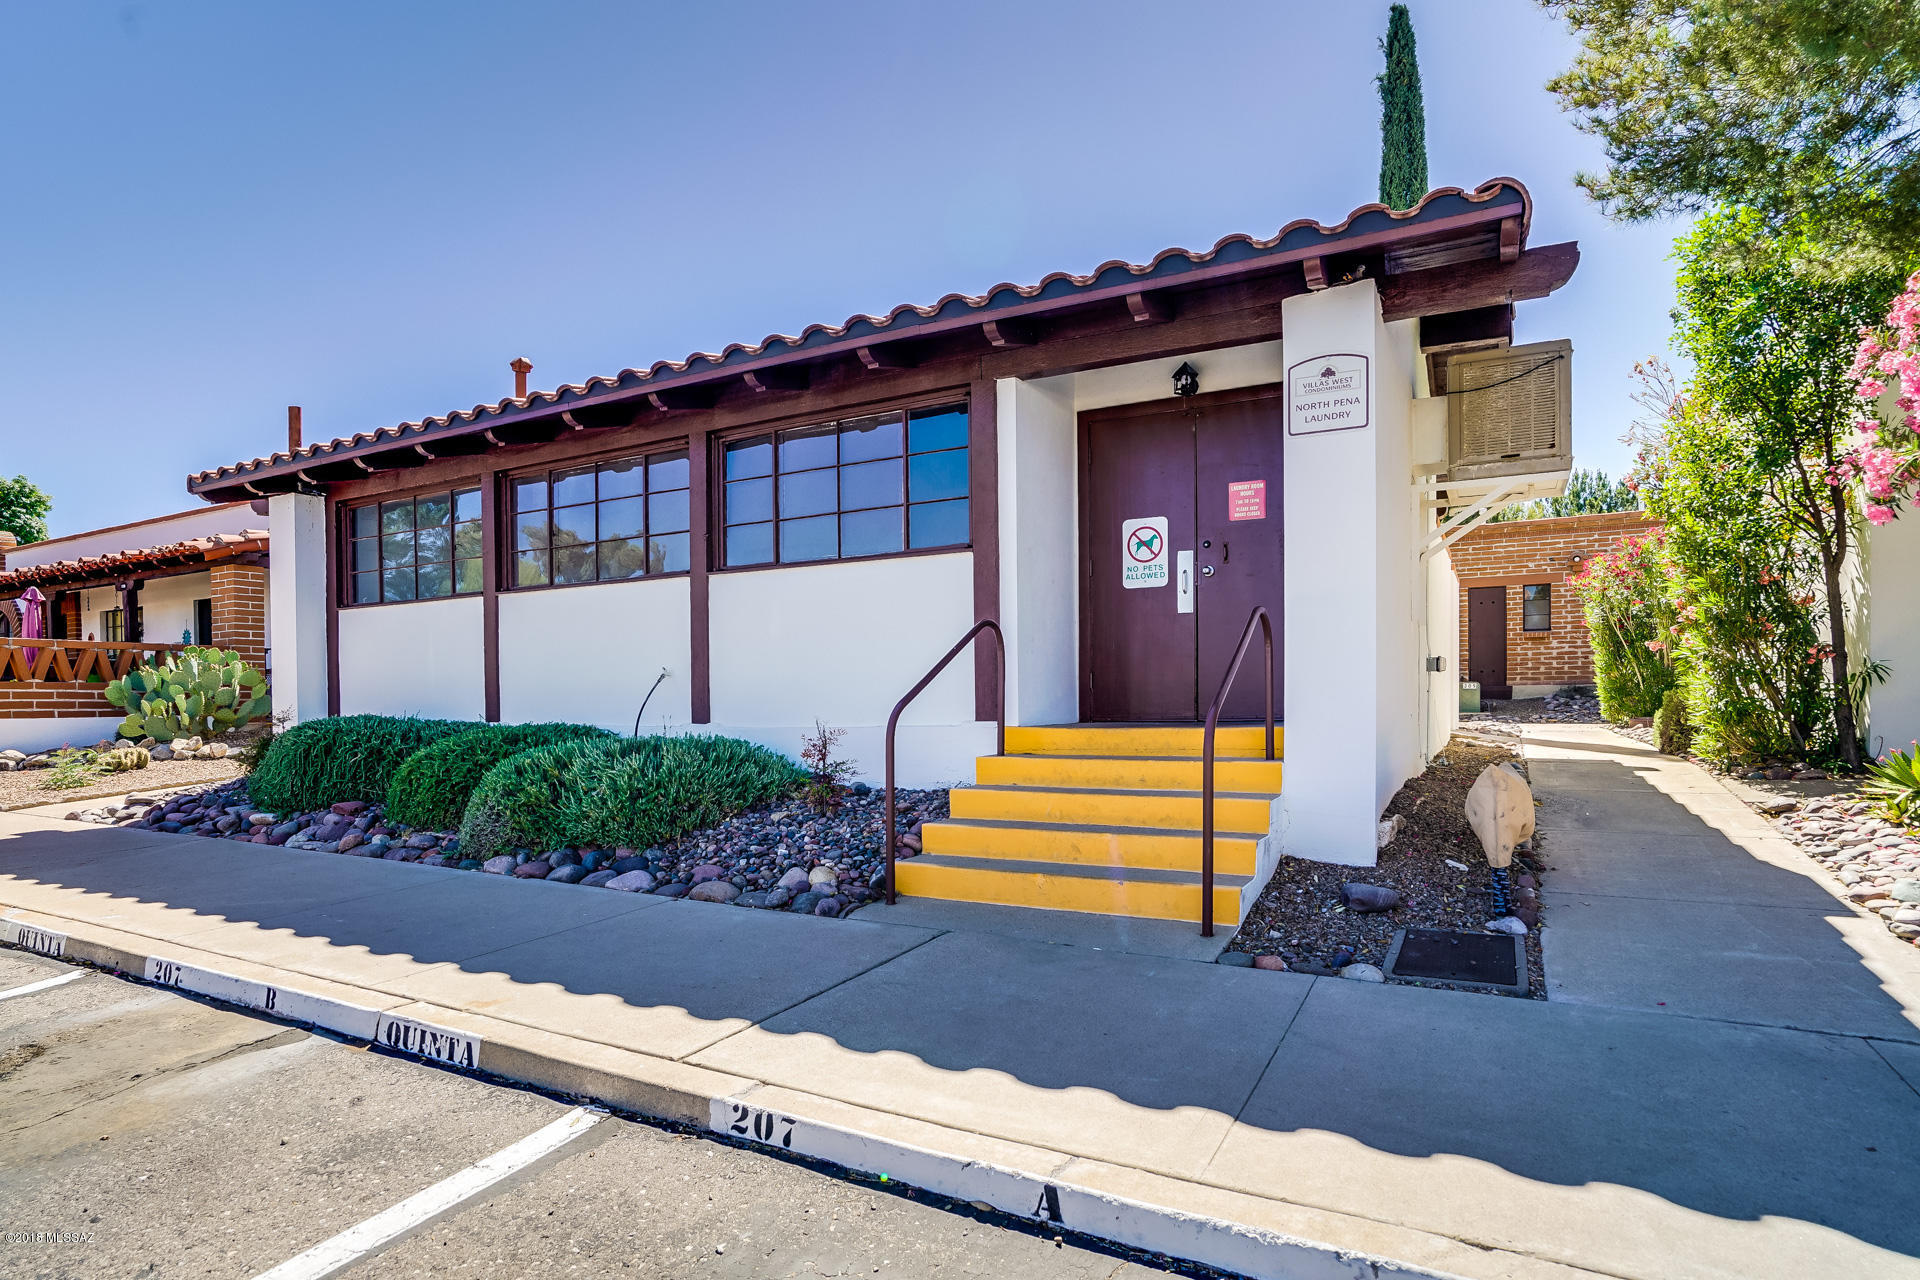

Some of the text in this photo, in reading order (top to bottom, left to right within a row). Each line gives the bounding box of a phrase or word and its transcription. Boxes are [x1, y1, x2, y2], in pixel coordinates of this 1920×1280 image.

[1303, 376, 1353, 389] VILLAS WEST
[1304, 383, 1352, 394] CONDOMINIUMS
[1295, 397, 1361, 412] NORTH PENA
[1304, 410, 1351, 423] LAUNDRY
[1143, 564, 1164, 572] PETS
[1126, 571, 1166, 580] ALLOWED
[18, 928, 61, 957] QUINTA
[155, 961, 474, 1067] 207 B QUINTA
[731, 1103, 1064, 1223] 207 A
